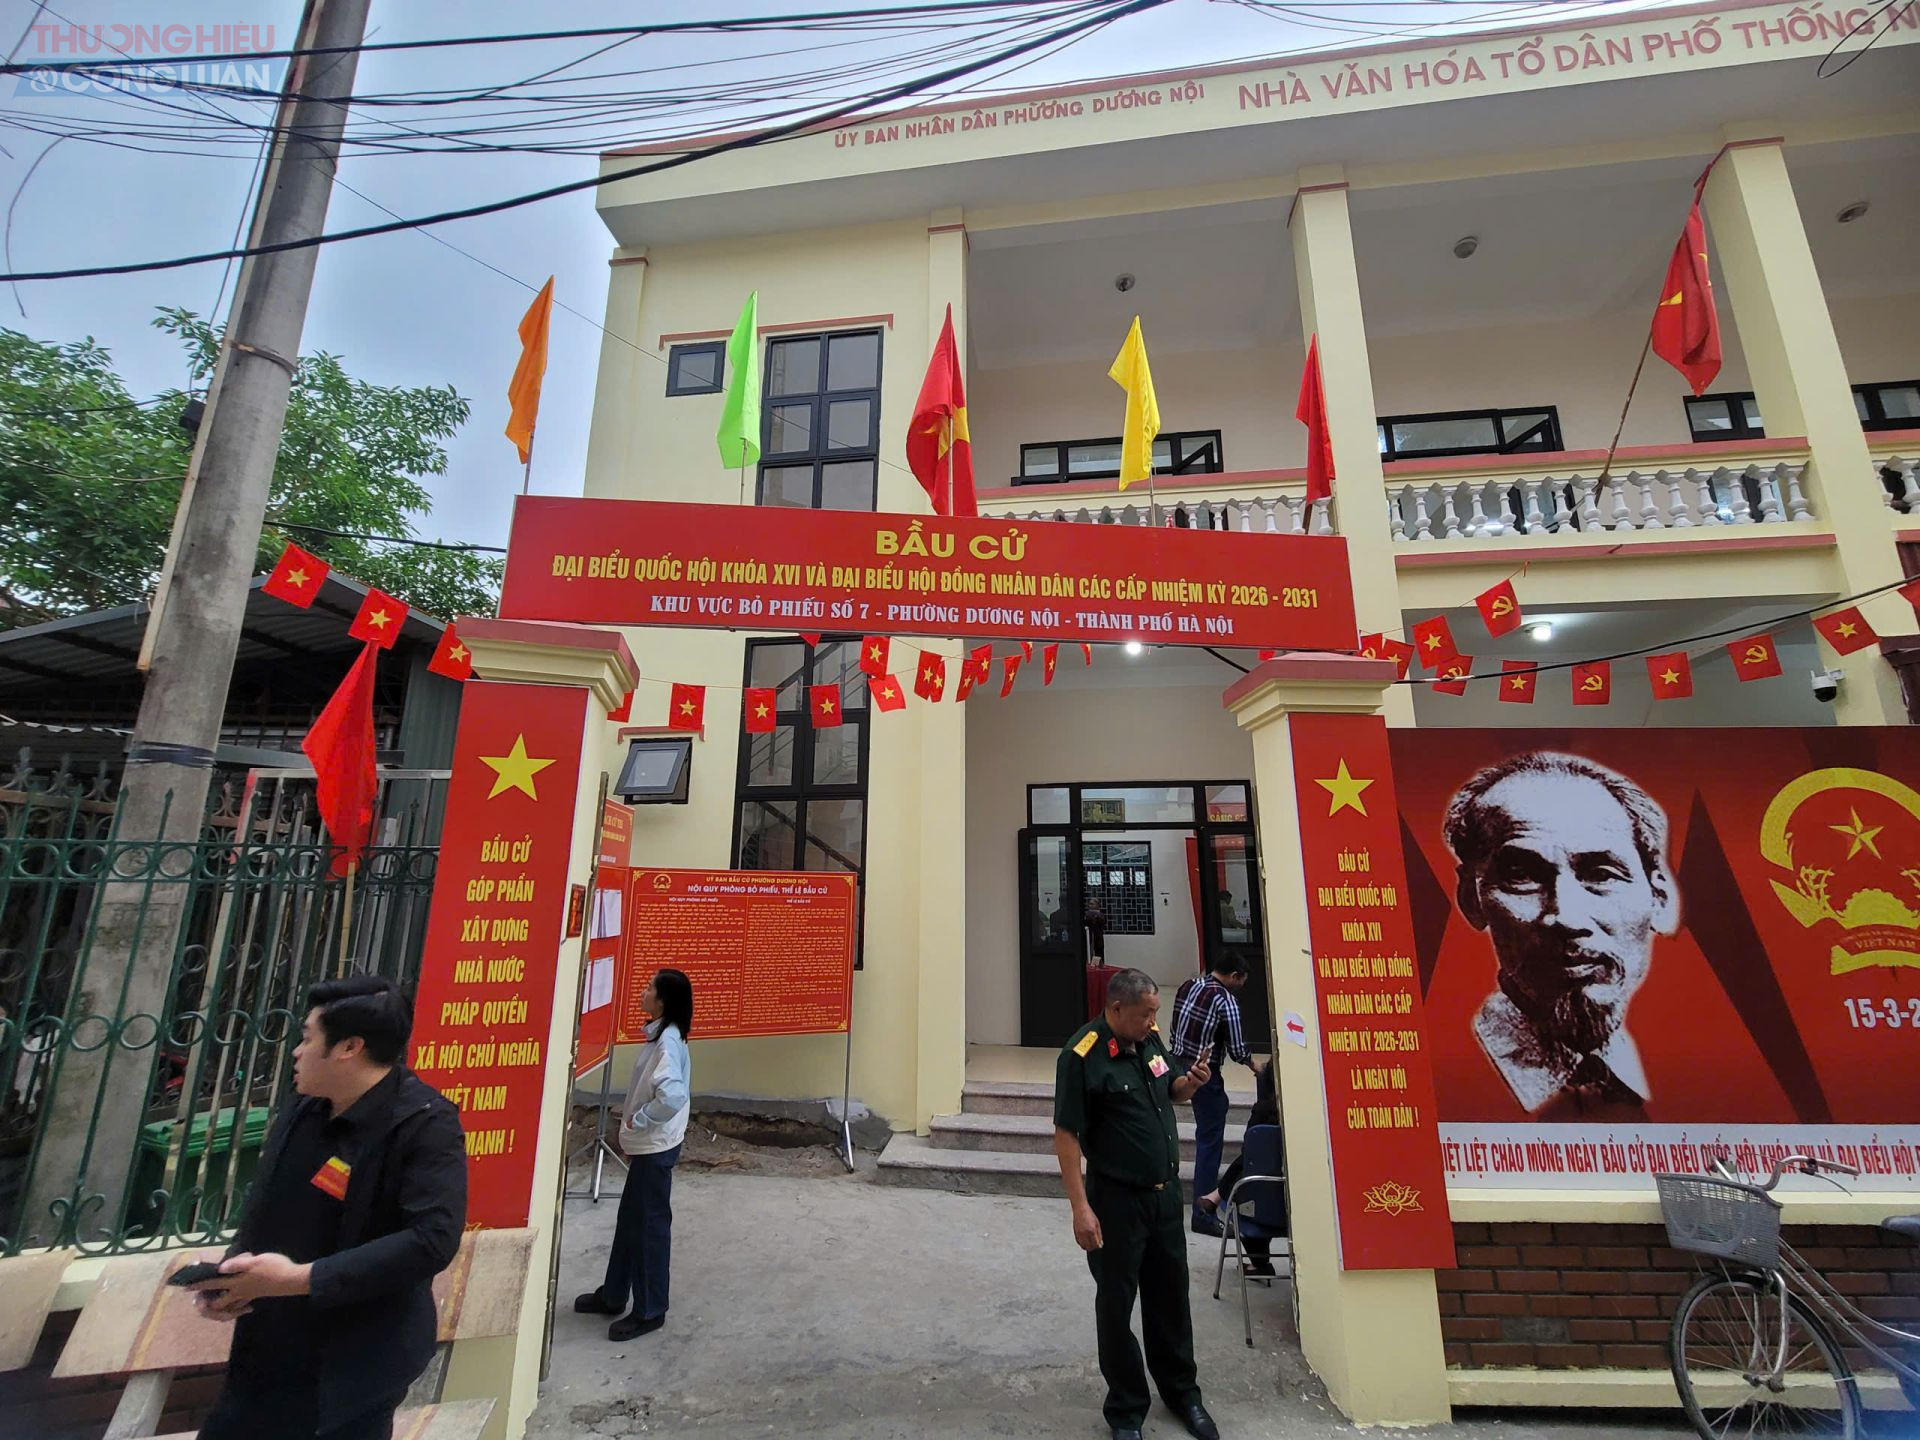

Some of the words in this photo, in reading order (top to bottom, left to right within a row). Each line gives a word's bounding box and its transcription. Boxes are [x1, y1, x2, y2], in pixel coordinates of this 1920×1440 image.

[1238, 70, 1311, 110] NHÀ
[1320, 62, 1393, 99] VĂN
[1404, 49, 1486, 89] HÓA
[1490, 36, 1546, 78] TỔ
[1553, 32, 1633, 72] DÂN
[1642, 16, 1722, 61] PHỐ
[1732, 2, 1876, 48] THỐNG
[1886, 3, 1920, 32] N
[865, 125, 898, 145] BAN
[906, 116, 954, 139] NHÂN
[962, 109, 997, 131] DÂN
[1093, 88, 1162, 113] DƯƠNG
[1170, 79, 1205, 104] NỘI
[876, 519, 955, 558] BẦU
[969, 528, 1028, 561] CỬ
[552, 555, 584, 581] ĐẠI
[588, 549, 630, 579] BIỂU
[634, 552, 682, 582] QUỐC
[687, 557, 716, 586] HỘI
[721, 558, 767, 584] KHÓA
[772, 564, 800, 586] XVI
[806, 561, 826, 587] VÀ
[832, 567, 860, 592] ĐẠI
[865, 560, 903, 590] BIỂU
[908, 566, 936, 595] HỘI
[941, 566, 985, 594] ĐỒNG
[991, 571, 1036, 596] NHÂN
[1041, 572, 1074, 598] DÂN
[1079, 574, 1111, 599] CÁC
[1115, 573, 1146, 600] CẤP
[1152, 578, 1203, 607] NHIỆM
[1207, 580, 1226, 604] KỲ
[1231, 585, 1268, 607] 2026
[1283, 588, 1318, 608] 2031
[651, 595, 691, 613] KHU
[697, 596, 732, 616] VỰC
[738, 595, 763, 615] BỎ
[768, 597, 825, 618] PHIẾU
[831, 598, 855, 619] SỐ
[859, 604, 870, 620] 7
[887, 602, 960, 624] PHƯỜNG
[966, 607, 1024, 626] DƯƠNG
[1030, 608, 1060, 629] NỘI
[1076, 609, 1132, 630] THÀNH
[1138, 612, 1173, 632] PHỐ
[1178, 614, 1200, 633] HÀ
[1205, 615, 1234, 637] NỘI
[481, 834, 508, 862] BẦU
[511, 834, 532, 863] CỬ
[1357, 847, 1370, 872] CỬ
[467, 875, 495, 902] GÓP
[497, 872, 534, 902] PHẦN
[688, 884, 701, 894] NỘI
[703, 885, 719, 893] QUY
[720, 885, 745, 893] PHÒNG
[1318, 887, 1334, 910] ĐẠI
[1335, 880, 1356, 906] BIỂU
[1357, 880, 1380, 908] QUỐC
[1381, 883, 1397, 910] HỘI
[461, 915, 489, 942] XÂY
[491, 917, 529, 947] DỰNG
[1341, 918, 1366, 941] KHÓA
[1366, 922, 1382, 941] XVI
[454, 955, 483, 983] NHÀ
[487, 955, 525, 983] NƯỚC
[1318, 954, 1332, 978] VÀ
[1332, 958, 1348, 982] ĐẠI
[1349, 949, 1370, 978] BIỂU
[1371, 953, 1387, 982] HỘI
[1388, 951, 1413, 977] ĐỒNG
[440, 997, 479, 1026] PHÁP
[482, 993, 528, 1027] QUYỀN
[1327, 990, 1353, 1014] NHÂN
[1354, 990, 1373, 1014] DÂN
[1374, 989, 1393, 1014] CÁC
[1394, 986, 1412, 1014] CẤP
[415, 1041, 434, 1070] XÃ
[438, 1040, 463, 1074] HỘI
[466, 1035, 495, 1068] CHỦ
[498, 1037, 540, 1066] NGHĨA
[1328, 1027, 1359, 1056] NHIỆM
[1359, 1026, 1371, 1052] KỲ
[1373, 1030, 1419, 1052] 2026-2031
[1351, 1064, 1364, 1090] LÀ
[1364, 1064, 1389, 1089] NGÀY
[1390, 1064, 1407, 1094] HỘI
[472, 1086, 507, 1111] NAM
[1347, 1100, 1367, 1129] CỦA
[1367, 1102, 1392, 1129] TOÀN
[1393, 1102, 1413, 1128] DÂN
[1414, 1107, 1420, 1127] !
[464, 1129, 506, 1161] MẠNH
[508, 1129, 515, 1153] !
[1463, 1137, 1488, 1178] LIỆT
[1491, 1137, 1524, 1172] CHÀO
[1525, 1137, 1564, 1172] MỪNG
[1564, 1137, 1598, 1172] NGÀY
[1600, 1133, 1626, 1173] BẦU
[1628, 1134, 1646, 1173] CỬ
[1669, 1131, 1700, 1173] BIỂU
[1734, 1138, 1759, 1180] HỘI
[1860, 1133, 1891, 1174] BIỂU
[1891, 1139, 1916, 1181] HỘI
